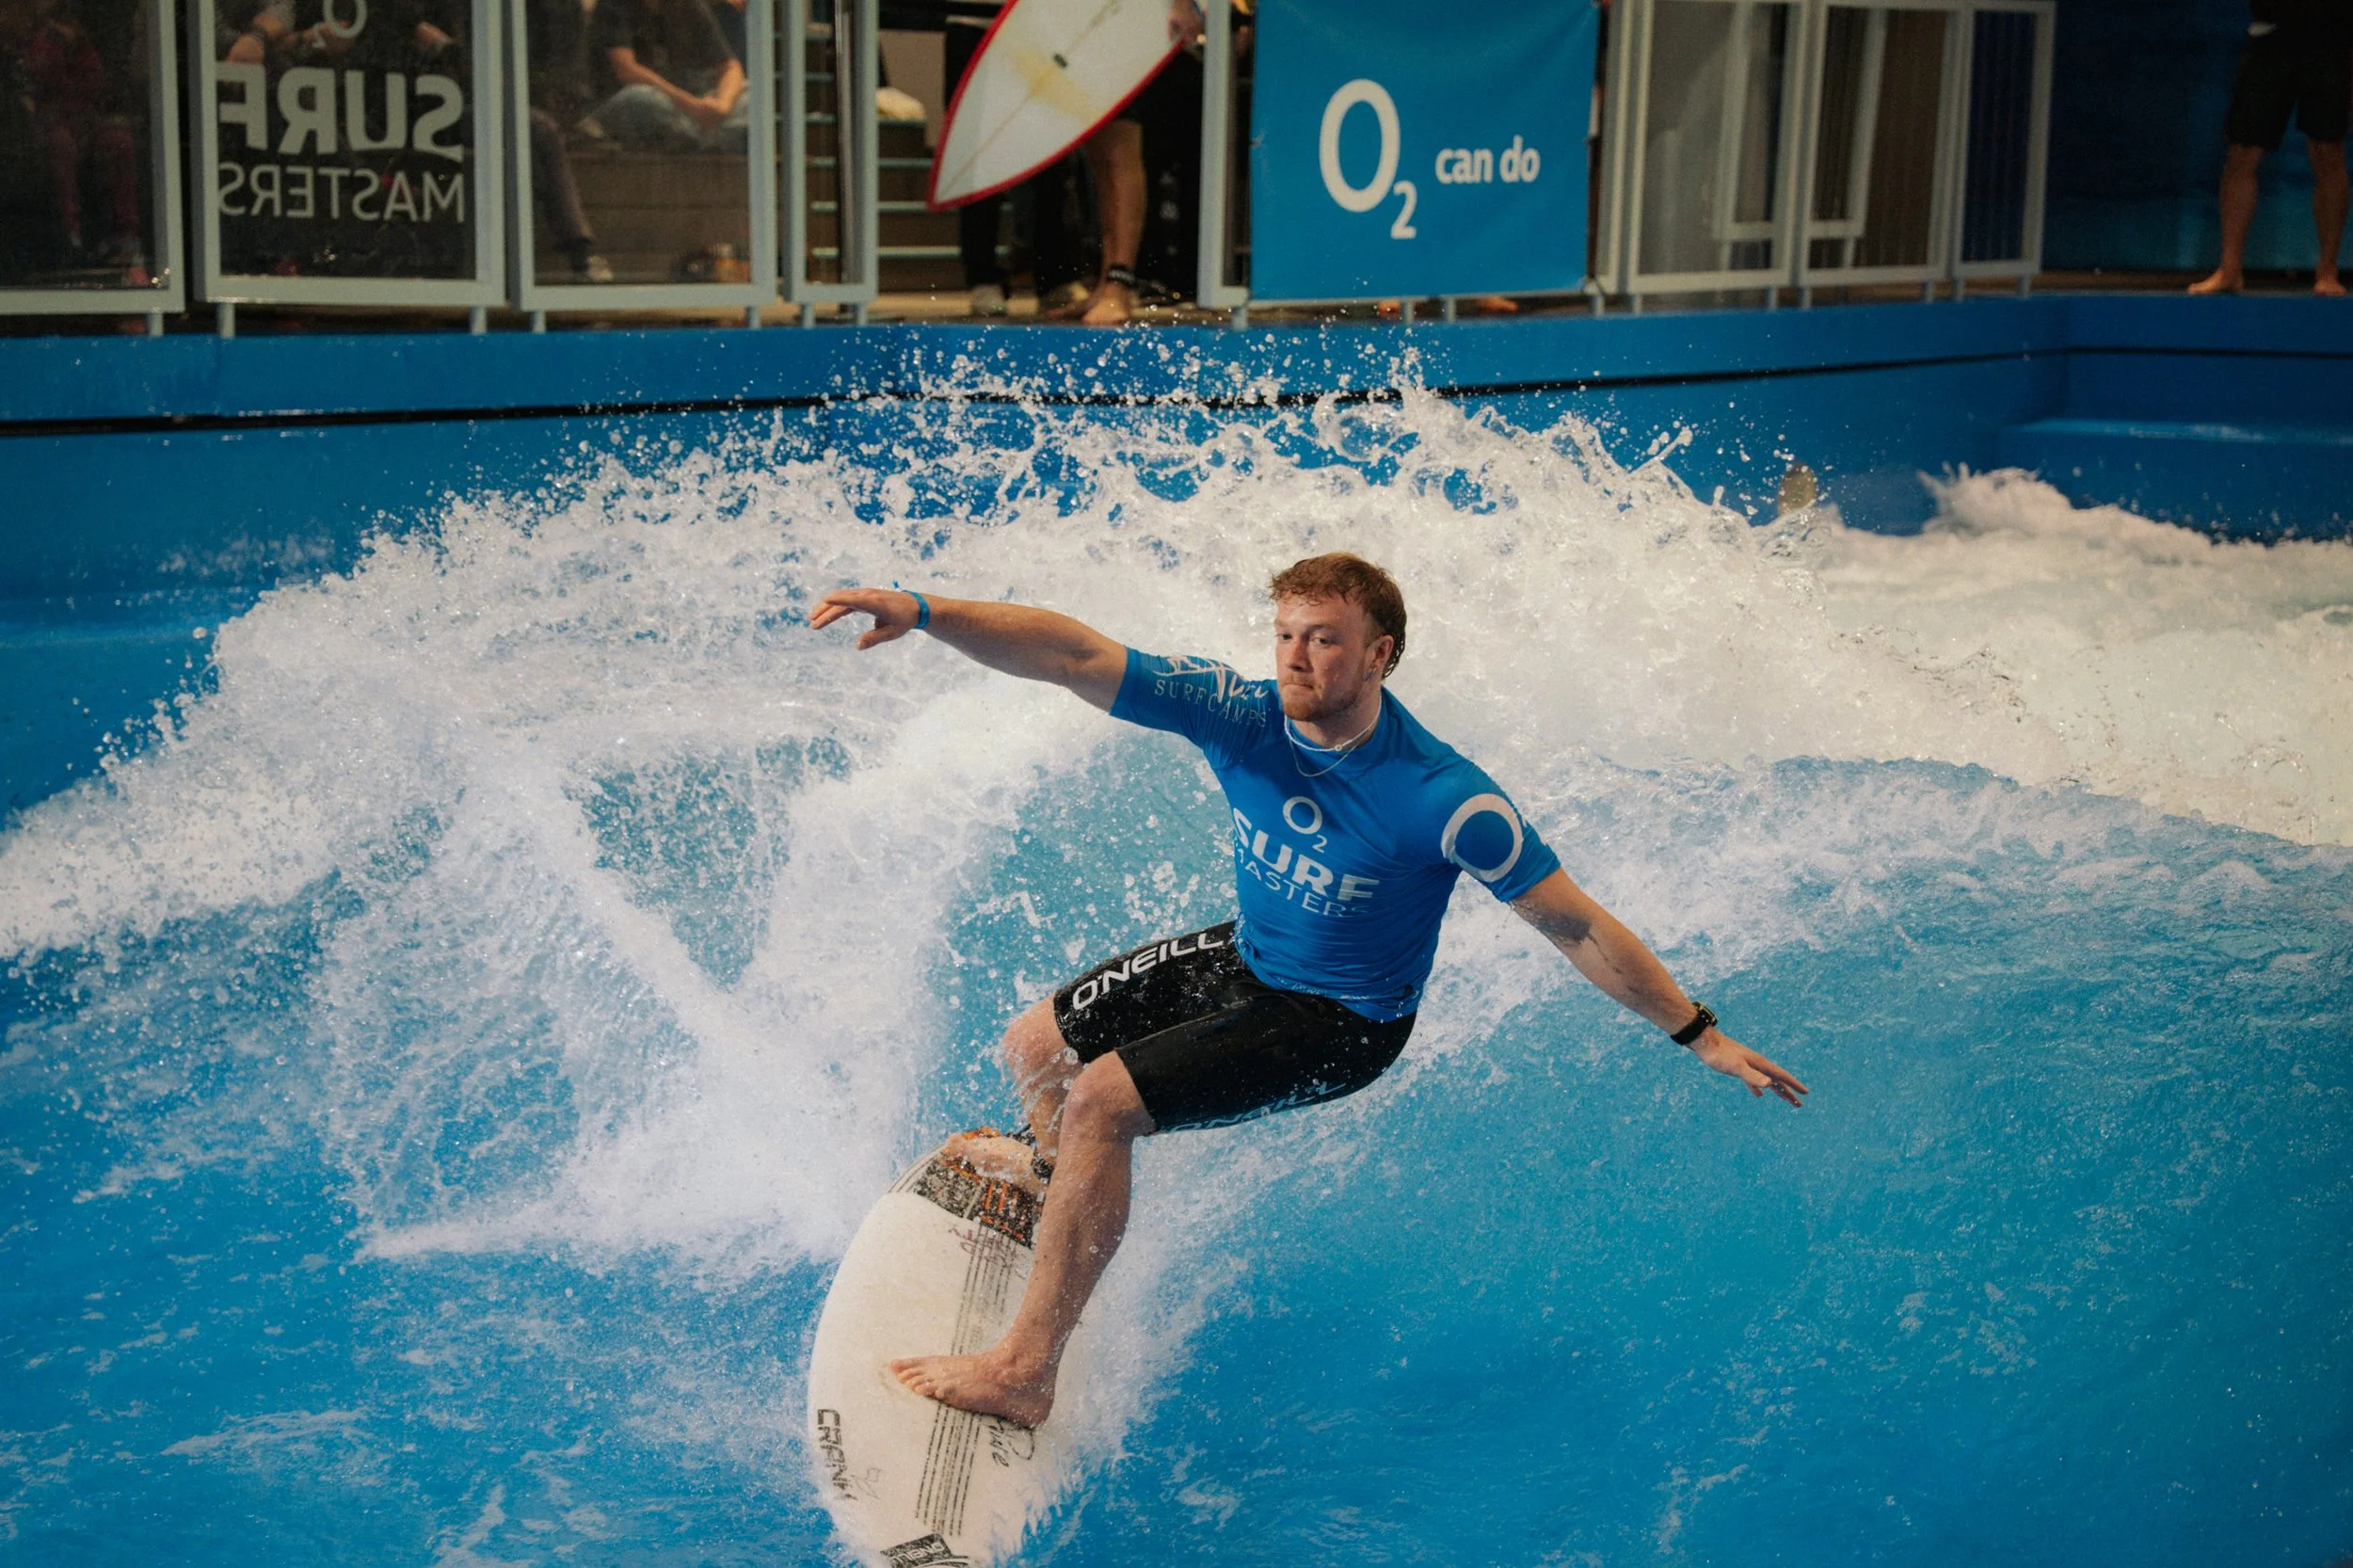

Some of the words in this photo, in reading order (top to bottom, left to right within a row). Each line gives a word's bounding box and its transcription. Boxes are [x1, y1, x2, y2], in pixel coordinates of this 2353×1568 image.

[1319, 78, 1417, 240] O2
[1434, 147, 1494, 184] can
[1499, 135, 1542, 183] do
[1233, 808, 1380, 902] SURF
[1282, 795, 1328, 854] O2
